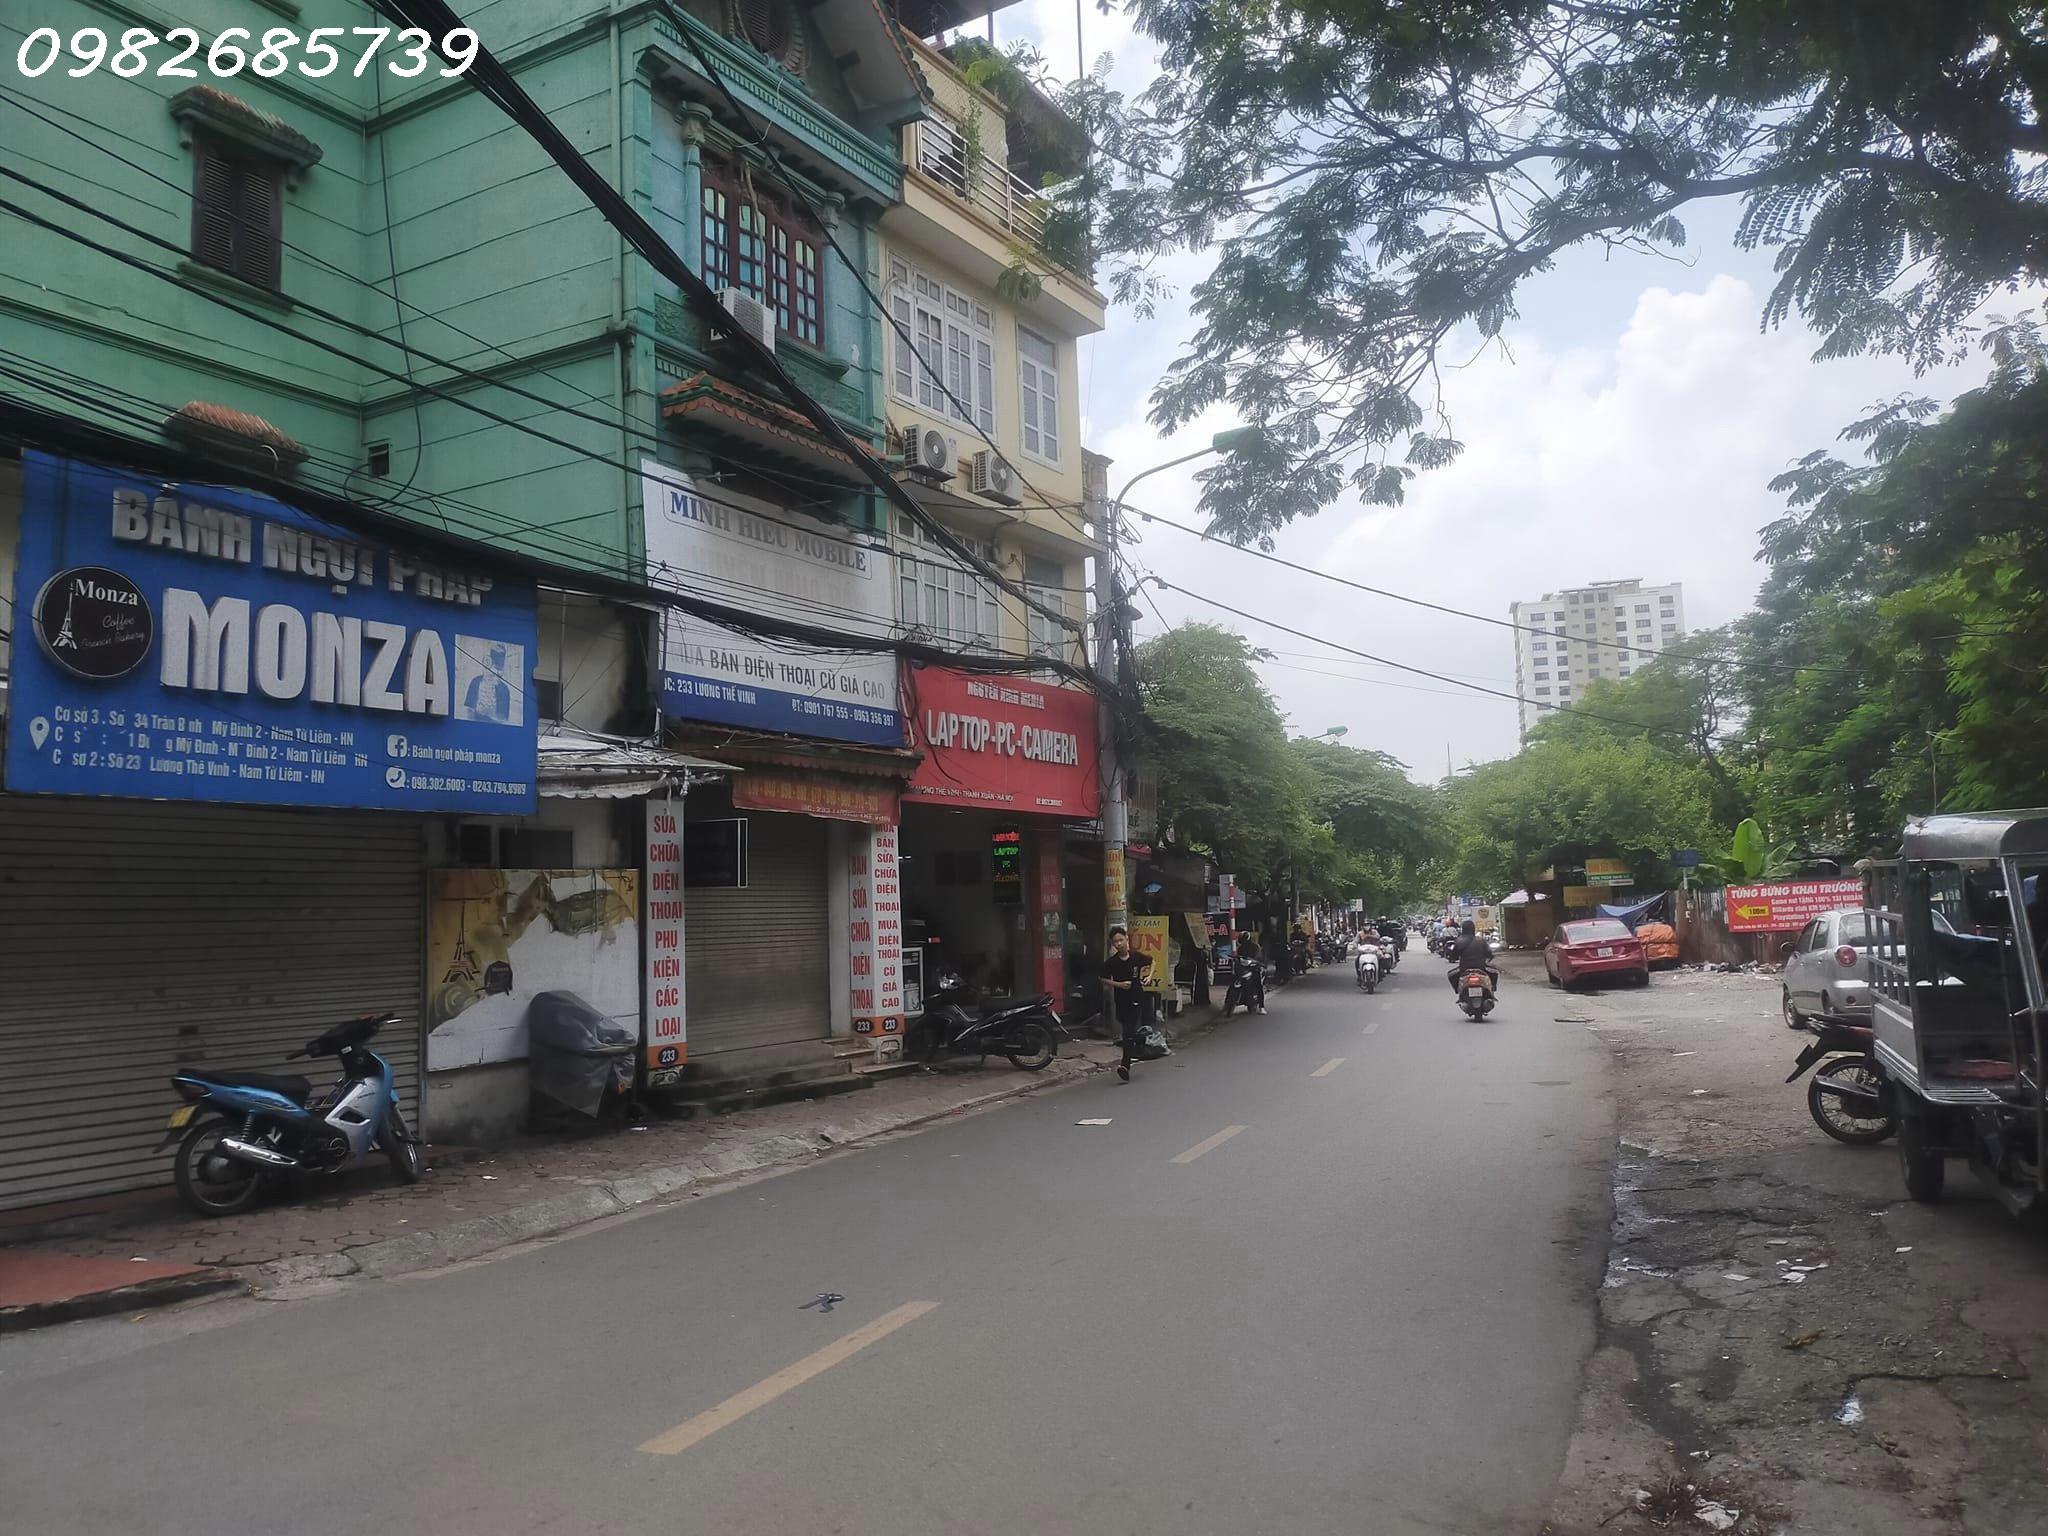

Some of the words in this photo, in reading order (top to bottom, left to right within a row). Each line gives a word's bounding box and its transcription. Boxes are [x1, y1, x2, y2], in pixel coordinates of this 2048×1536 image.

[670, 491, 730, 532] MINH
[795, 529, 866, 572] MOBILE
[75, 578, 138, 606] Monza
[160, 587, 449, 716] MONZA
[779, 663, 815, 690] THOẠI
[677, 678, 692, 695] 233
[340, 731, 354, 746] HN
[286, 747, 308, 763] Nam
[239, 763, 262, 779] Nam
[311, 769, 325, 784] HN
[1792, 884, 1817, 896] KHAI
[650, 901, 682, 923] THOẠI
[874, 902, 899, 914] THOẠI
[878, 920, 898, 930] MUA
[655, 930, 678, 952] PHỤ
[877, 949, 900, 961] THOẠI
[653, 956, 680, 981] KIỆN
[656, 985, 679, 1008] CÁC
[881, 997, 900, 1009] CAO
[655, 1016, 681, 1039] LOẠI
[857, 1021, 870, 1032] 233
[884, 1019, 896, 1030] 233
[661, 1049, 675, 1063] 233
